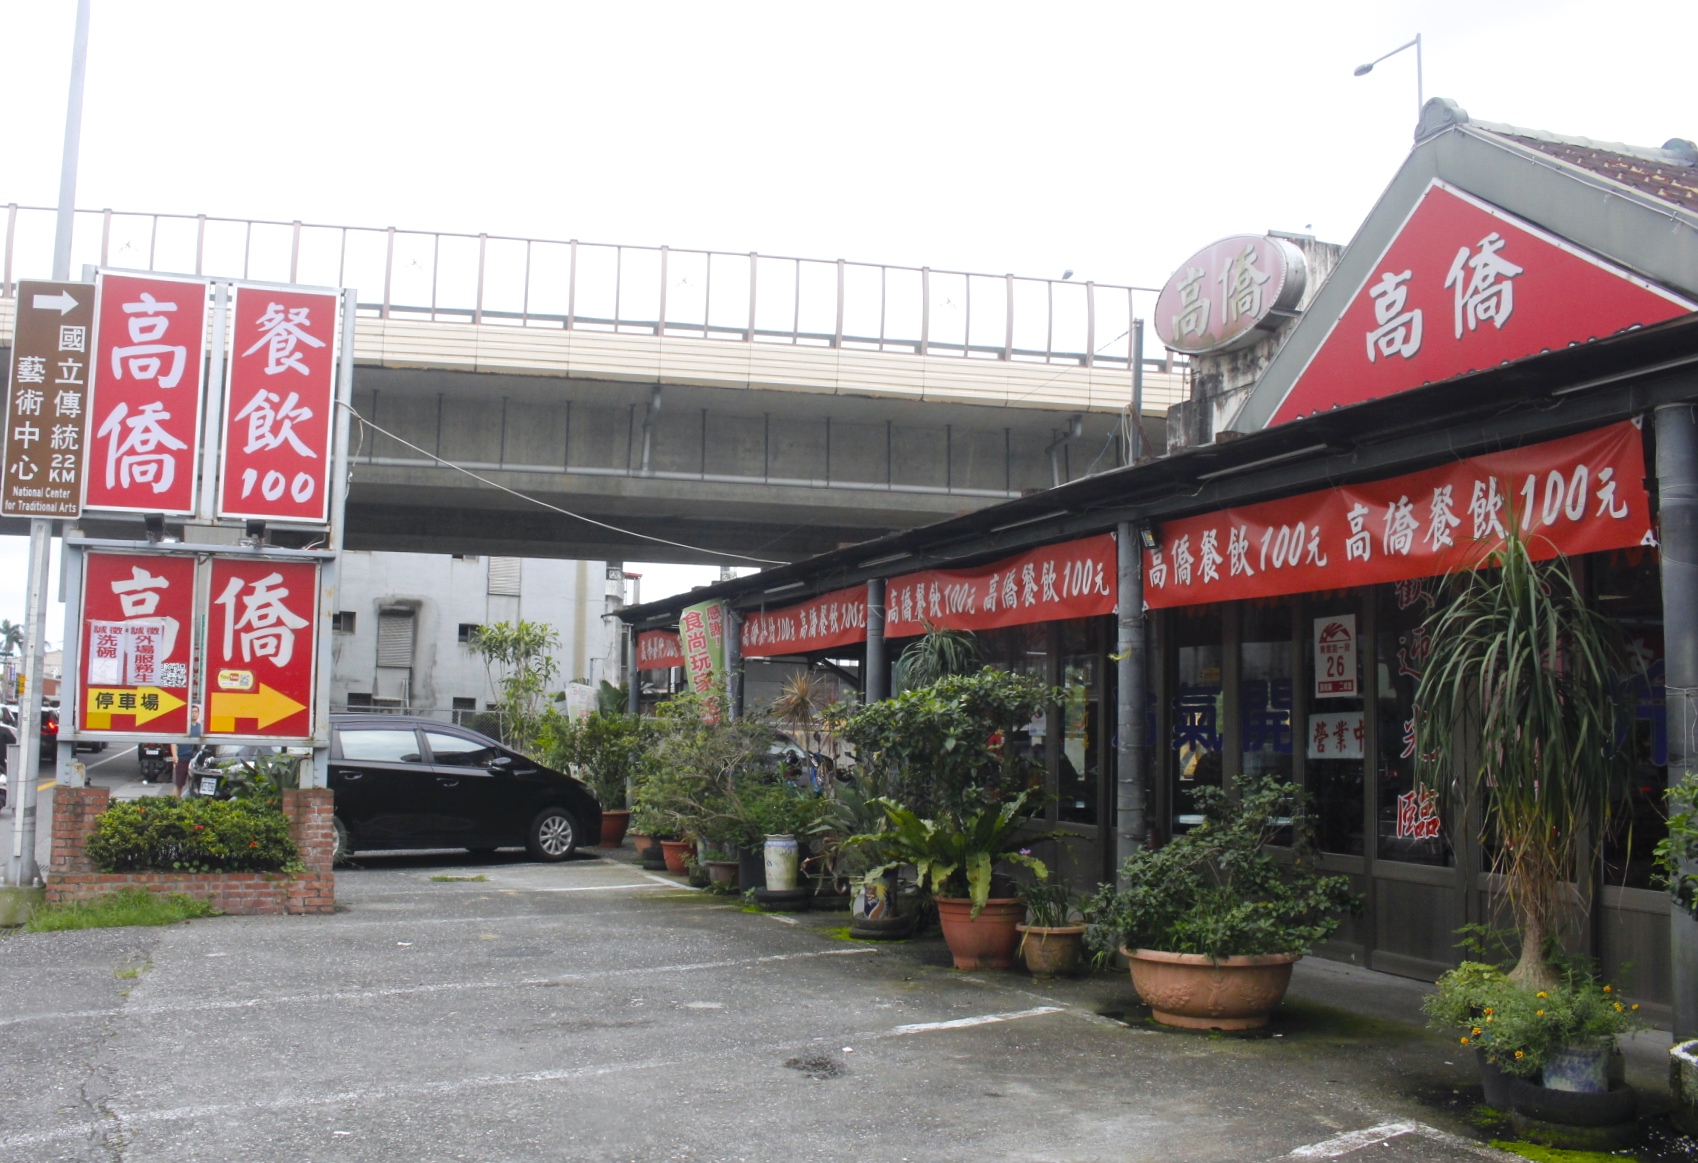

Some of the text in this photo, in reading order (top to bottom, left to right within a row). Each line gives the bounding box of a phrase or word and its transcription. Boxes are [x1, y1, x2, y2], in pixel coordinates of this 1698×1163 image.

[1172, 243, 1270, 340] 高僑
[1366, 232, 1522, 363] 高僑
[50, 325, 86, 451] 國立傳統
[97, 292, 188, 494] 高僑
[10, 356, 46, 481] 藝術中心
[49, 469, 75, 483] KM
[51, 454, 75, 468] 22
[5, 500, 76, 513] for Traditional Arts
[13, 486, 70, 499] National Center
[1148, 465, 1629, 589] 高僑餐飲100元 高僑餐飲100元
[214, 572, 310, 668] 僑
[96, 634, 118, 659] 洗碗
[134, 636, 155, 684] 外場服務生
[1327, 655, 1345, 677] 26
[95, 691, 160, 711] 停車場
[1313, 718, 1365, 754] 營業中
